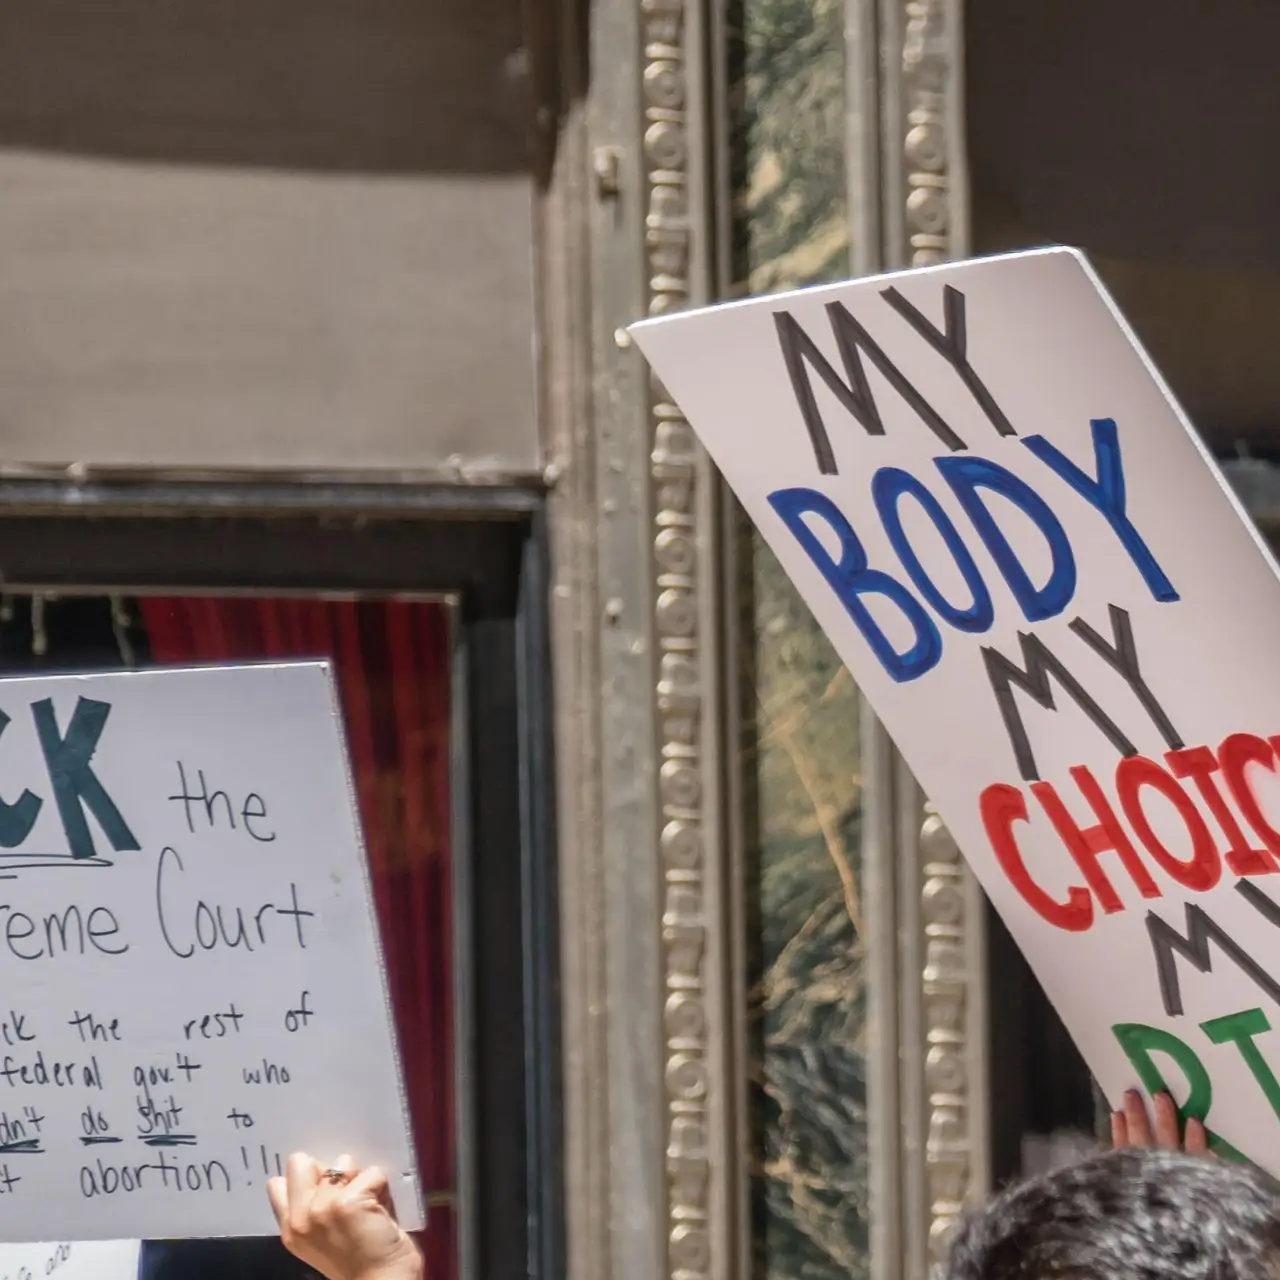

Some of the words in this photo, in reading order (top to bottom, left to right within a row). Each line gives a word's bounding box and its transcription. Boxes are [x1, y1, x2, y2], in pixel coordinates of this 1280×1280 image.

[773, 285, 1018, 475] MY
[767, 418, 1180, 683] BODY
[979, 603, 1184, 780] MY
[168, 760, 276, 842] the
[0, 904, 128, 960] eme
[156, 846, 314, 959] Court
[68, 1010, 121, 1042] the
[184, 1003, 244, 1040] rest
[285, 991, 314, 1033] of
[0, 1050, 103, 1090] federal
[242, 1058, 290, 1085] who
[81, 1105, 109, 1136] do
[227, 1107, 254, 1130] to
